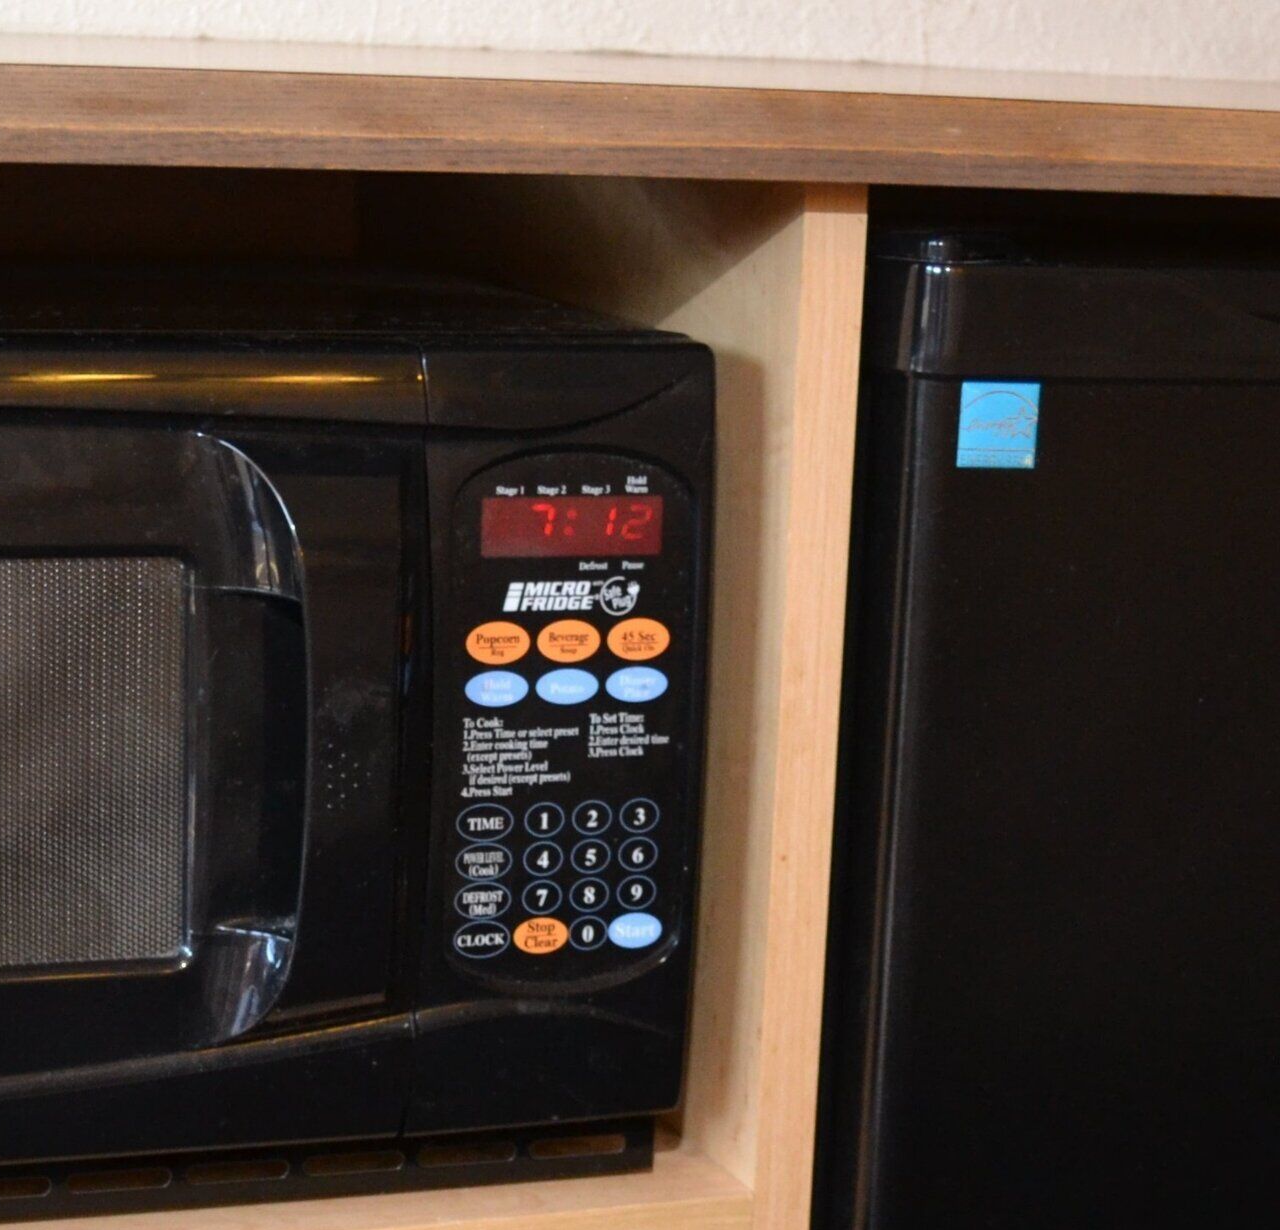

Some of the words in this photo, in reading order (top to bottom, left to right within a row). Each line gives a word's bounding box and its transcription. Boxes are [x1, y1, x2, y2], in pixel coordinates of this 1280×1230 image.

[496, 486, 518, 497] Stage
[520, 486, 524, 495] 1
[537, 485, 559, 496] Stage
[560, 484, 567, 494] 2
[581, 485, 602, 496] Stage
[604, 484, 611, 494] 3
[532, 503, 652, 540] 7:12
[524, 581, 591, 596] MICRO
[520, 596, 594, 611] FRIDGE
[476, 633, 520, 648] Popcorn
[548, 632, 589, 646] Beverage
[621, 631, 635, 642] 45
[638, 631, 656, 642] Sec
[463, 718, 475, 728] To
[476, 717, 503, 728] Cook:
[589, 714, 601, 724] To
[603, 714, 617, 723] Set
[618, 713, 644, 723] Time:
[494, 730, 516, 738] Time
[528, 727, 553, 737] select
[554, 727, 579, 738] preset
[619, 724, 644, 734] Clock
[495, 741, 527, 751] cooking
[529, 740, 548, 748] time
[621, 735, 649, 745] desired
[651, 735, 669, 743] time
[619, 747, 643, 756] Clock
[497, 763, 523, 772] Power
[524, 761, 548, 771] Level
[477, 774, 507, 784] desired
[493, 787, 512, 796] Start
[467, 817, 504, 831] TIME
[539, 812, 549, 830] 1
[586, 810, 598, 828] 2
[633, 808, 646, 826] 3
[536, 850, 550, 869] 4
[585, 848, 597, 867] 5
[632, 847, 644, 864] 6
[468, 864, 498, 876] (Cook)
[462, 890, 504, 904] DEFROST
[536, 889, 548, 907] 7
[583, 886, 596, 904] 8
[631, 884, 643, 901] 9
[527, 921, 555, 936] Stop
[582, 925, 594, 943] 0
[612, 922, 656, 938] Start
[457, 933, 504, 948] CLOCK
[524, 936, 558, 948] Clear
